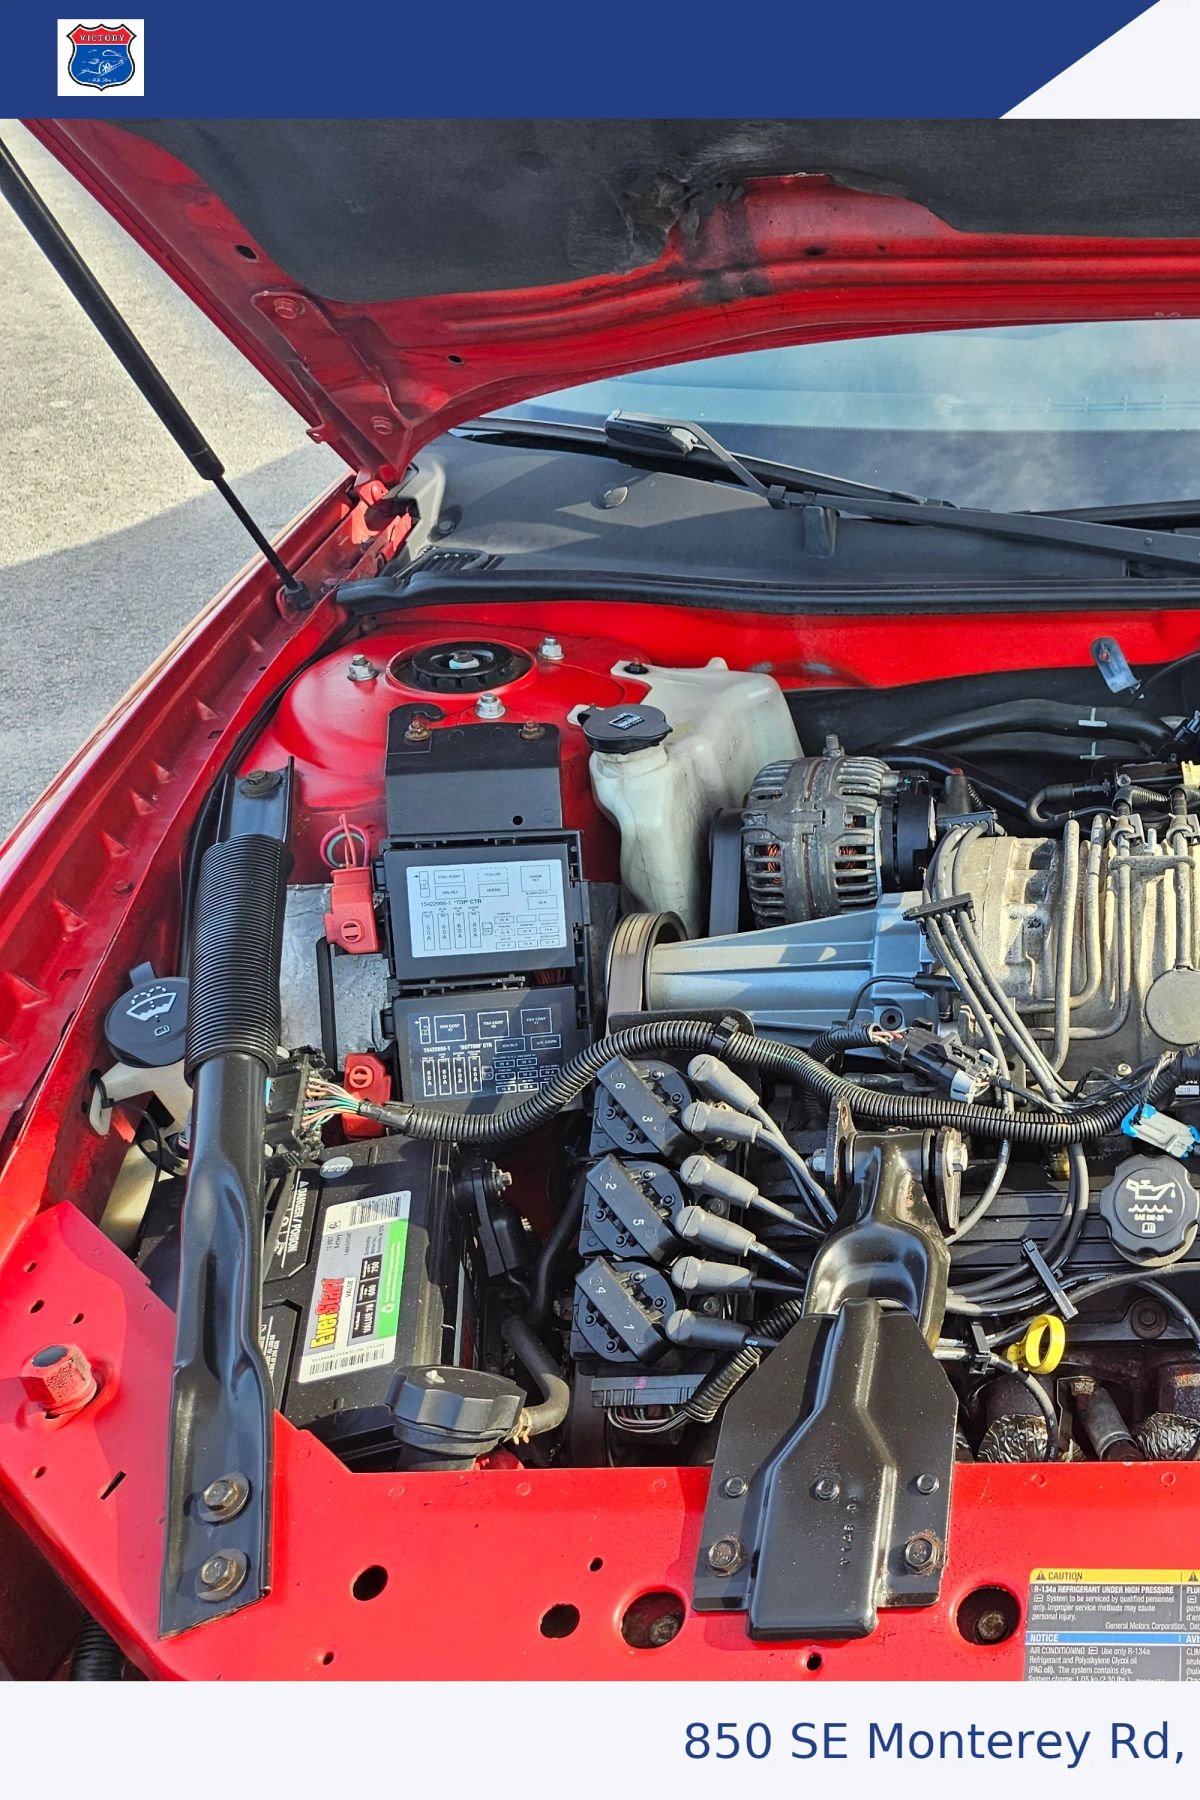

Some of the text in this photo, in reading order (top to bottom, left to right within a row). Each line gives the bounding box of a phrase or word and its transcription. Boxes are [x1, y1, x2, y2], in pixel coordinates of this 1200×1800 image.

[294, 1187, 309, 1218] DANGER
[287, 1223, 302, 1252] POISON
[345, 1279, 353, 1298] VALUE
[311, 1278, 345, 1349] EverStart
[362, 1311, 373, 1333] VALUE
[1049, 1572, 1082, 1580] CAUTION
[1047, 1595, 1068, 1603] System
[1076, 1595, 1084, 1603] be
[1086, 1595, 1110, 1603] serviced
[1112, 1595, 1118, 1603] by
[1120, 1595, 1144, 1603] qualified
[1145, 1595, 1174, 1603] personnel
[1032, 1613, 1057, 1621] personal
[1106, 1622, 1129, 1631] General
[1130, 1622, 1150, 1631] Motors
[1030, 1634, 1058, 1642] NOTICE
[1030, 1647, 1150, 1655] AIR CONDITIONING Use only R-134a
[1029, 1666, 1042, 1674] (PAG
[1058, 1666, 1069, 1674] The
[1071, 1666, 1092, 1674] system
[1094, 1666, 1119, 1674] contains
